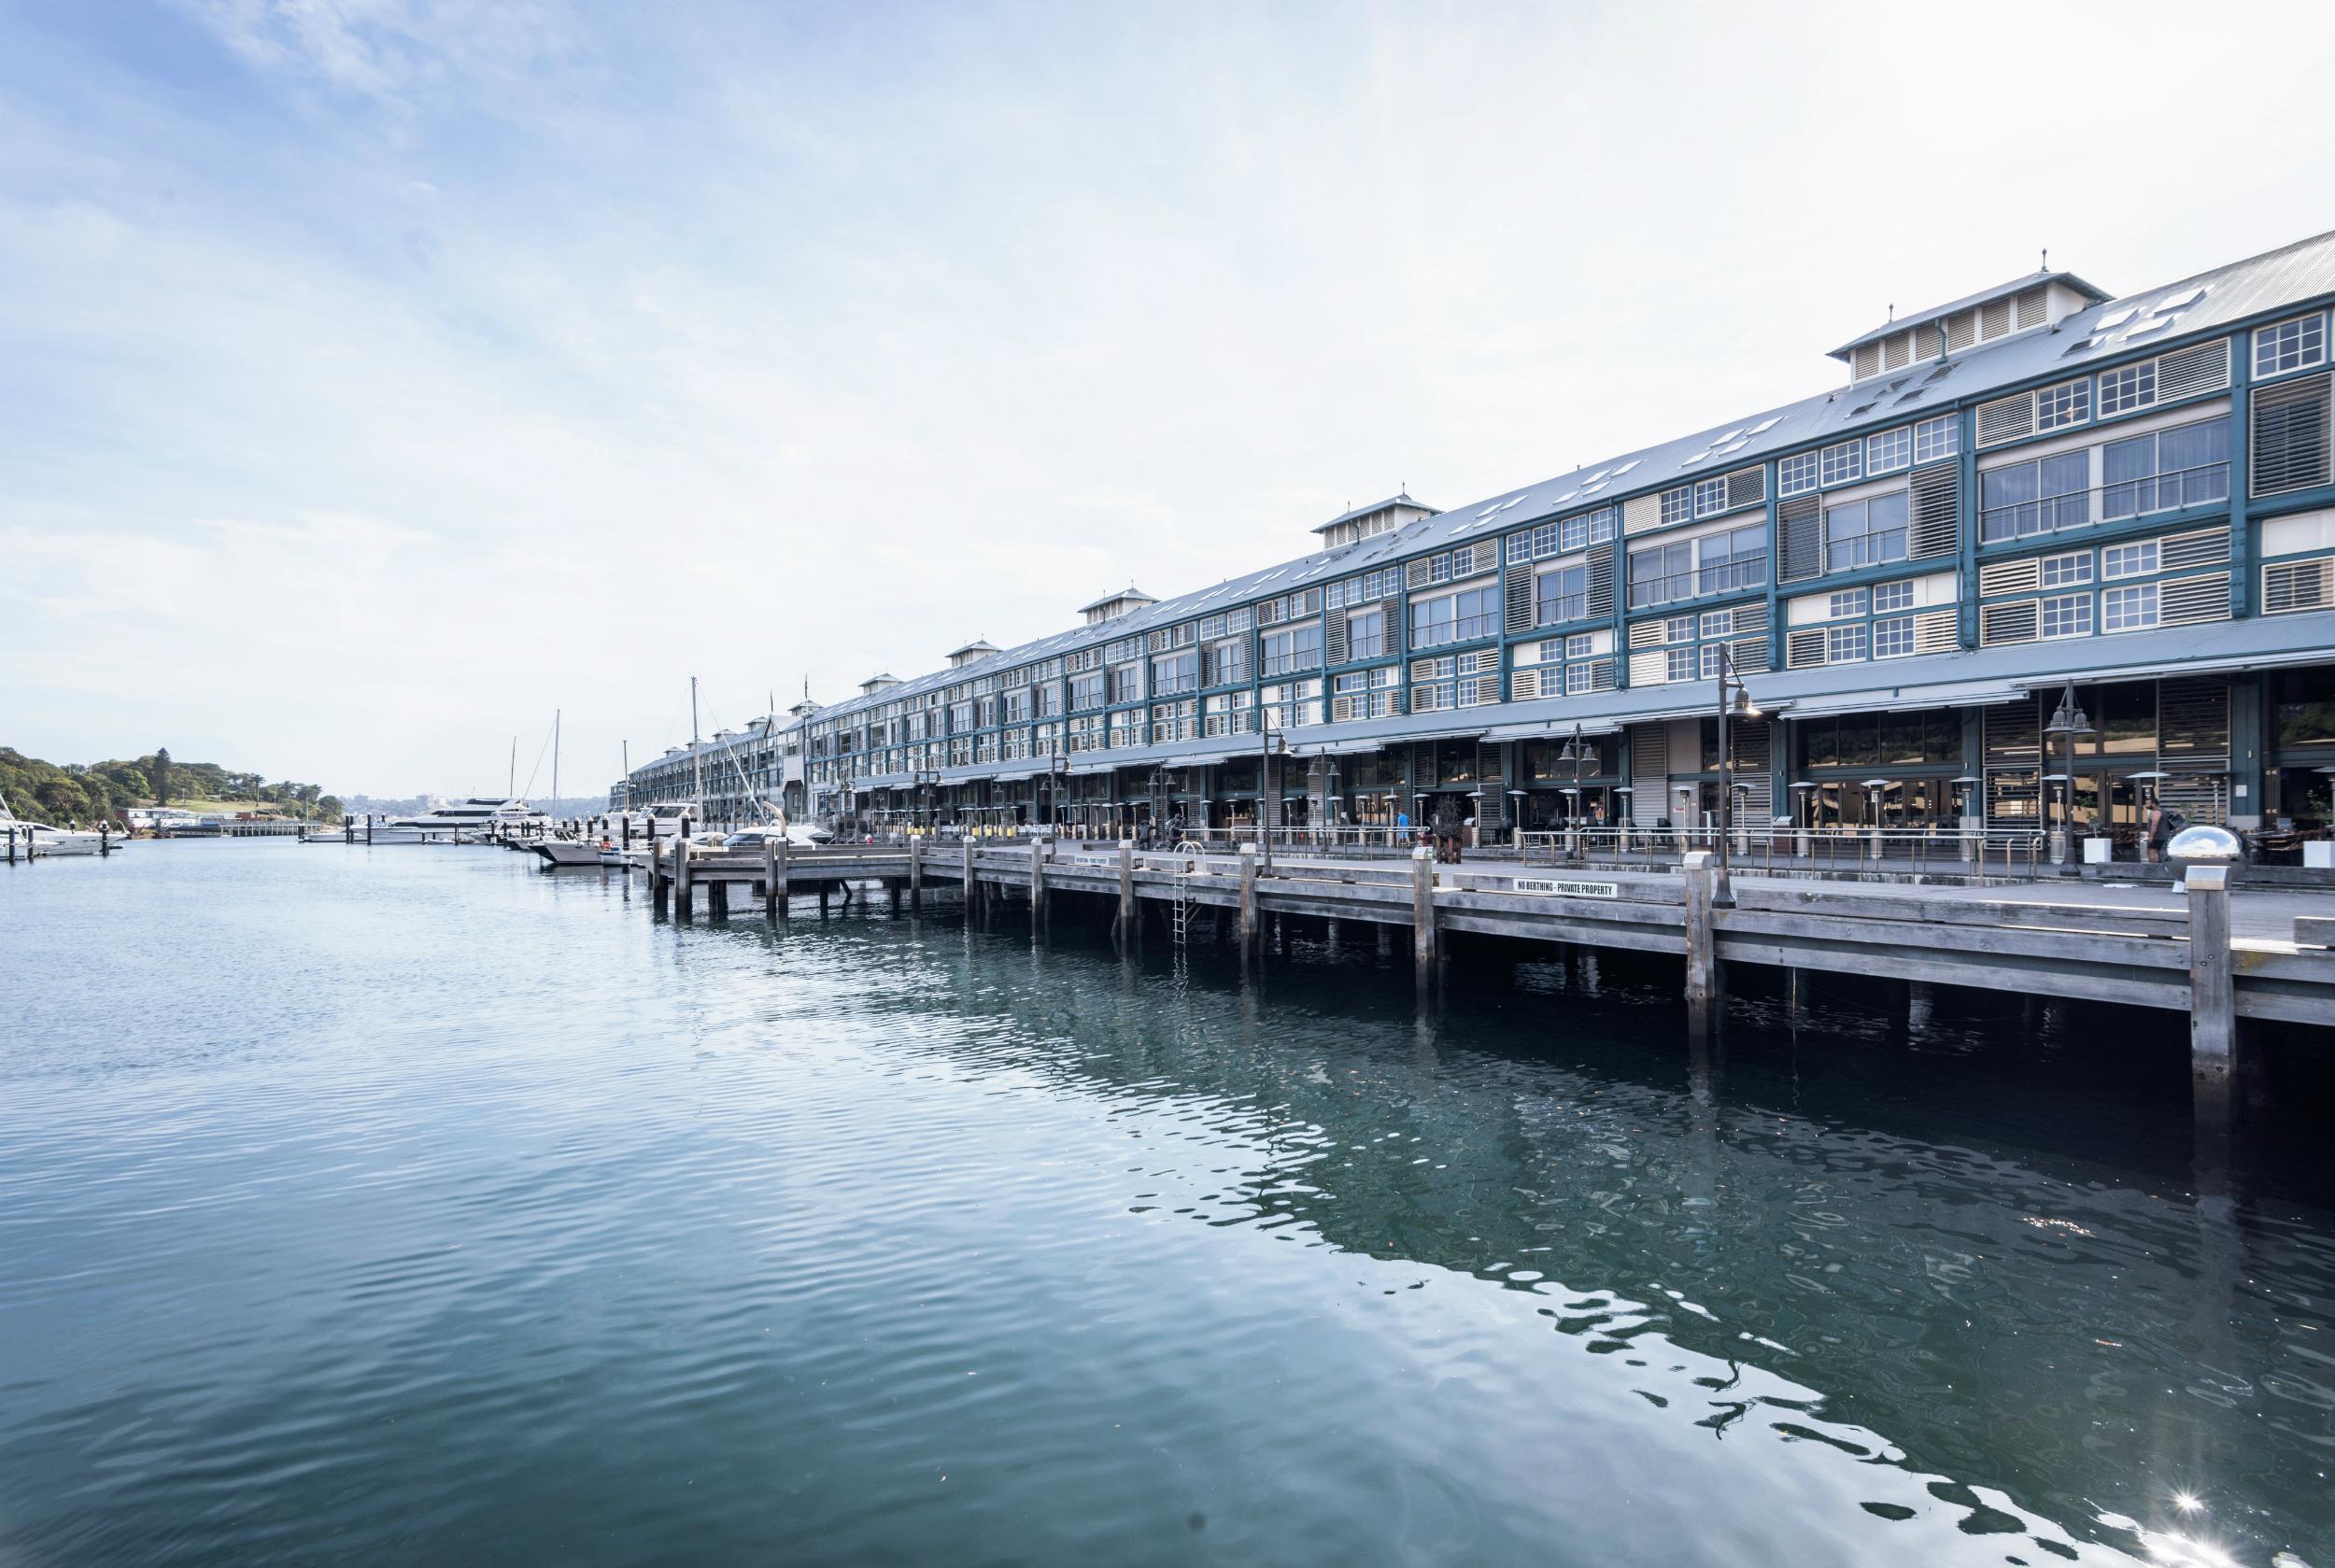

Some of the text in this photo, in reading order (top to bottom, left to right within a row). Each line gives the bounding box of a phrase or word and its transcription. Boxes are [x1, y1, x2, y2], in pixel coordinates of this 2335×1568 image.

[1518, 881, 1525, 890] NO
[1526, 881, 1553, 892] BERTHING
[1557, 883, 1580, 894] PRIVATE
[1581, 884, 1612, 896] PROPERTY
